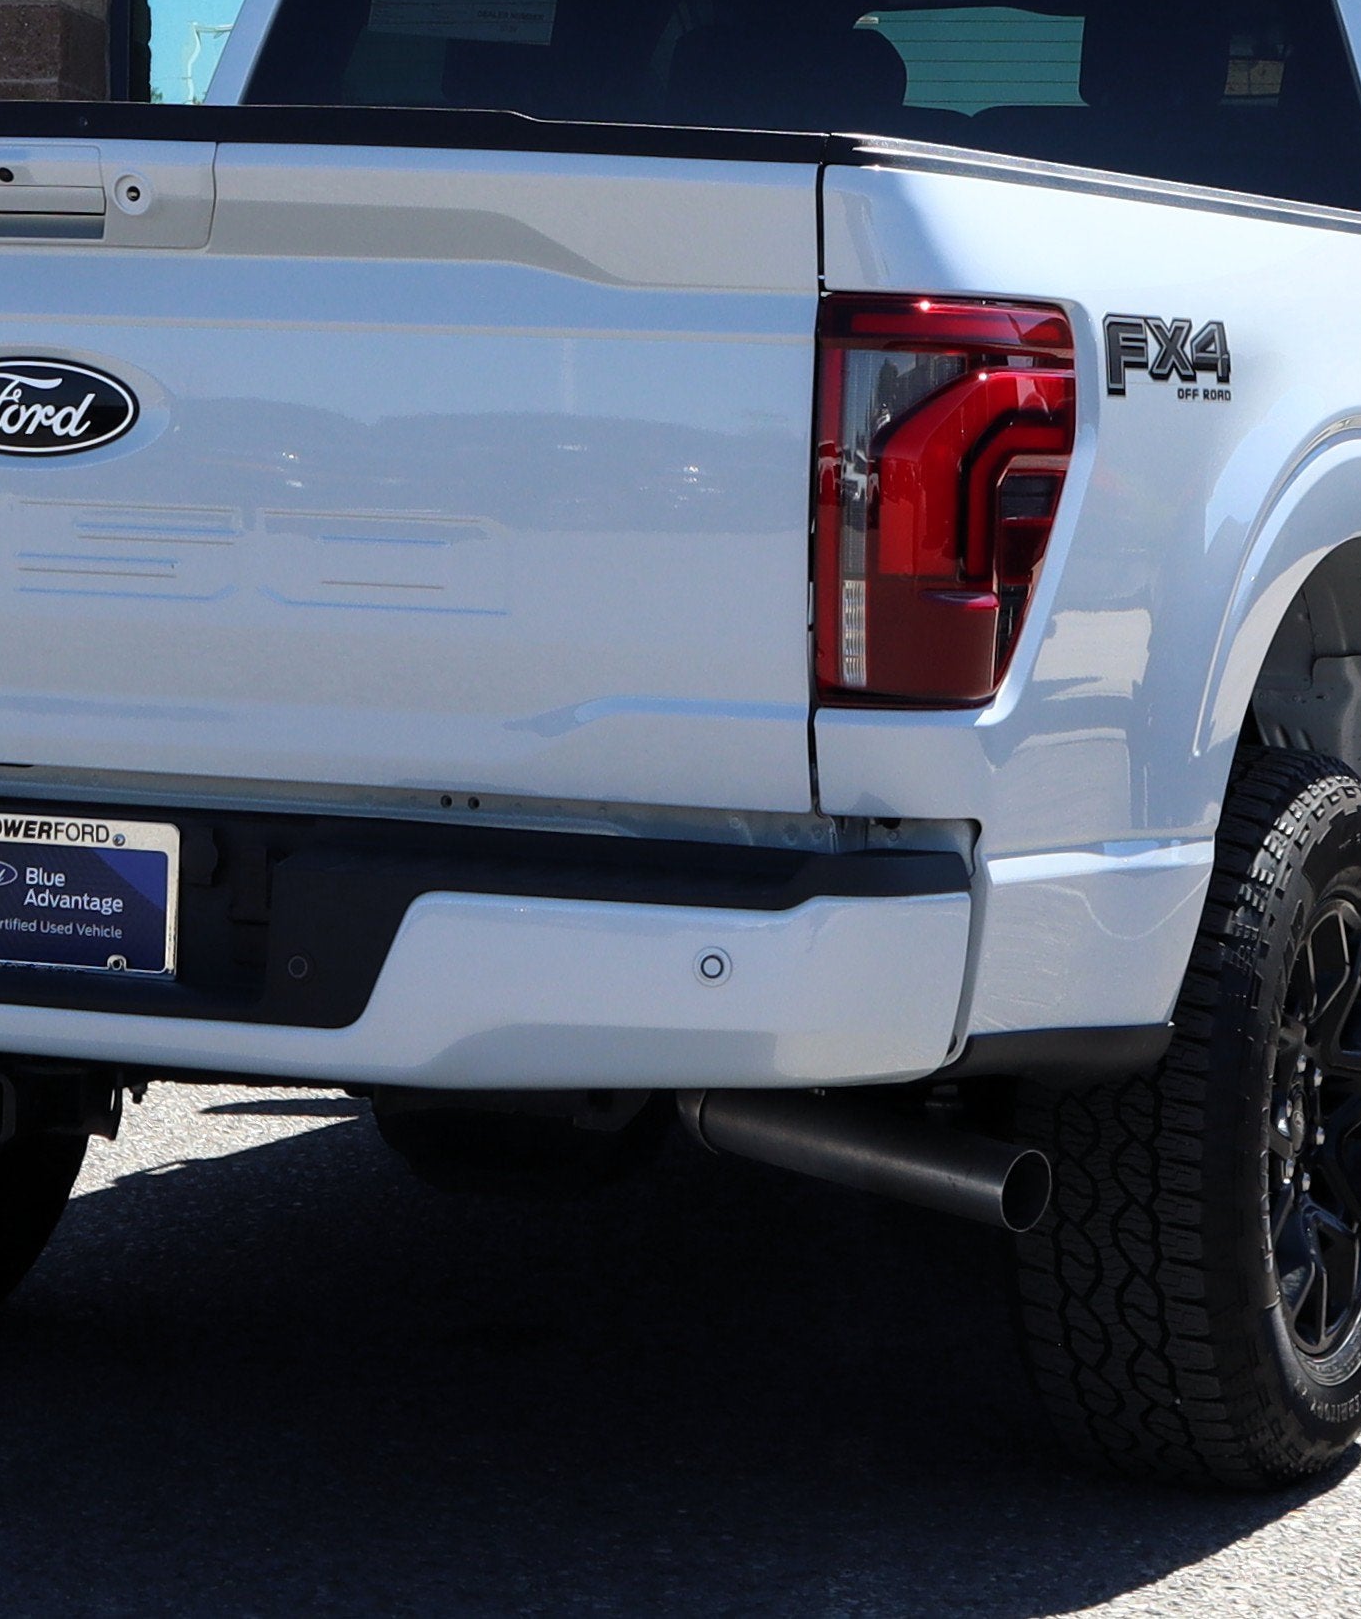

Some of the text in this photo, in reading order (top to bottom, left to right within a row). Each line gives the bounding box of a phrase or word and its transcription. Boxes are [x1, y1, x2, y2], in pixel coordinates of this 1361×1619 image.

[1102, 312, 1231, 396] FX4
[1177, 388, 1231, 401] OFF ROAD
[25, 867, 66, 886] Blue
[23, 889, 124, 915] Advantage
[40, 920, 73, 935] Used
[76, 923, 123, 939] Vehicle
